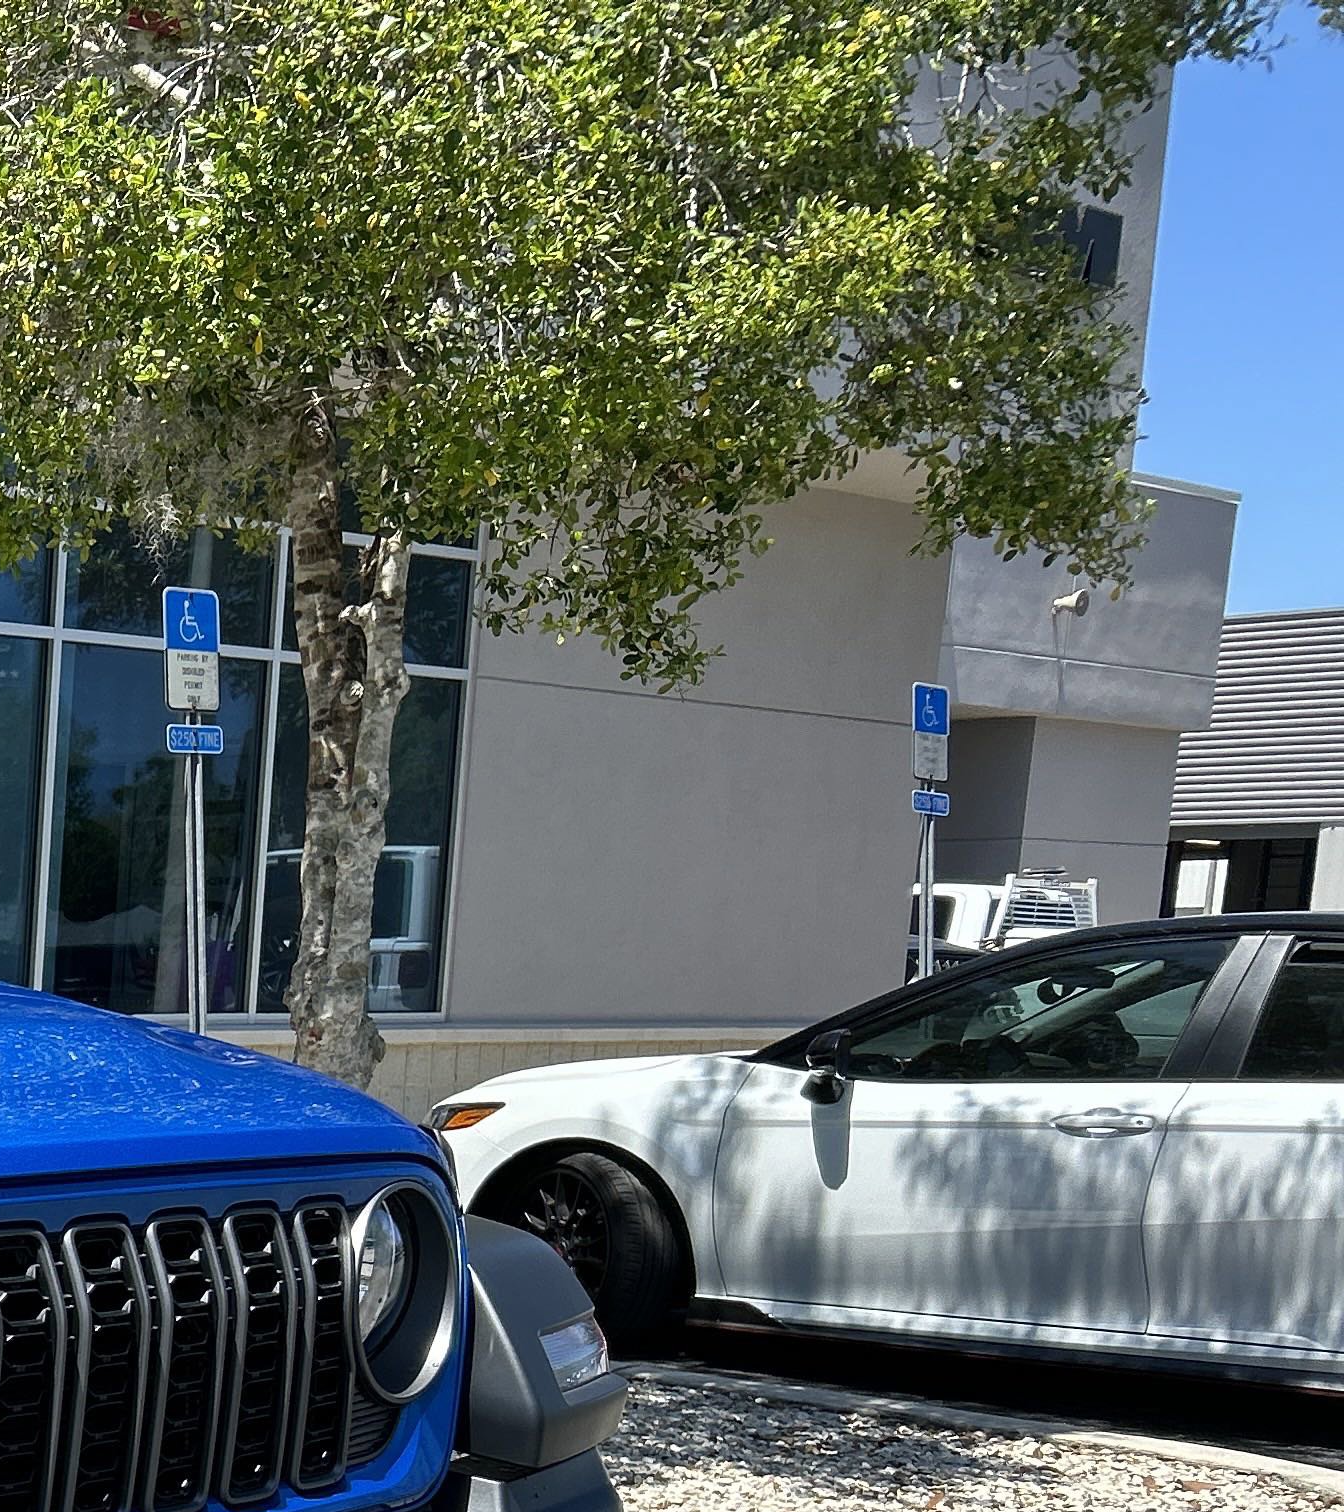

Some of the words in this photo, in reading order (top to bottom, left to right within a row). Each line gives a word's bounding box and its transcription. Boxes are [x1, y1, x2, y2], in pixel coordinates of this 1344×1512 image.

[176, 652, 199, 663] PARKING
[183, 680, 204, 690] PERMIT
[198, 731, 221, 749] FINE
